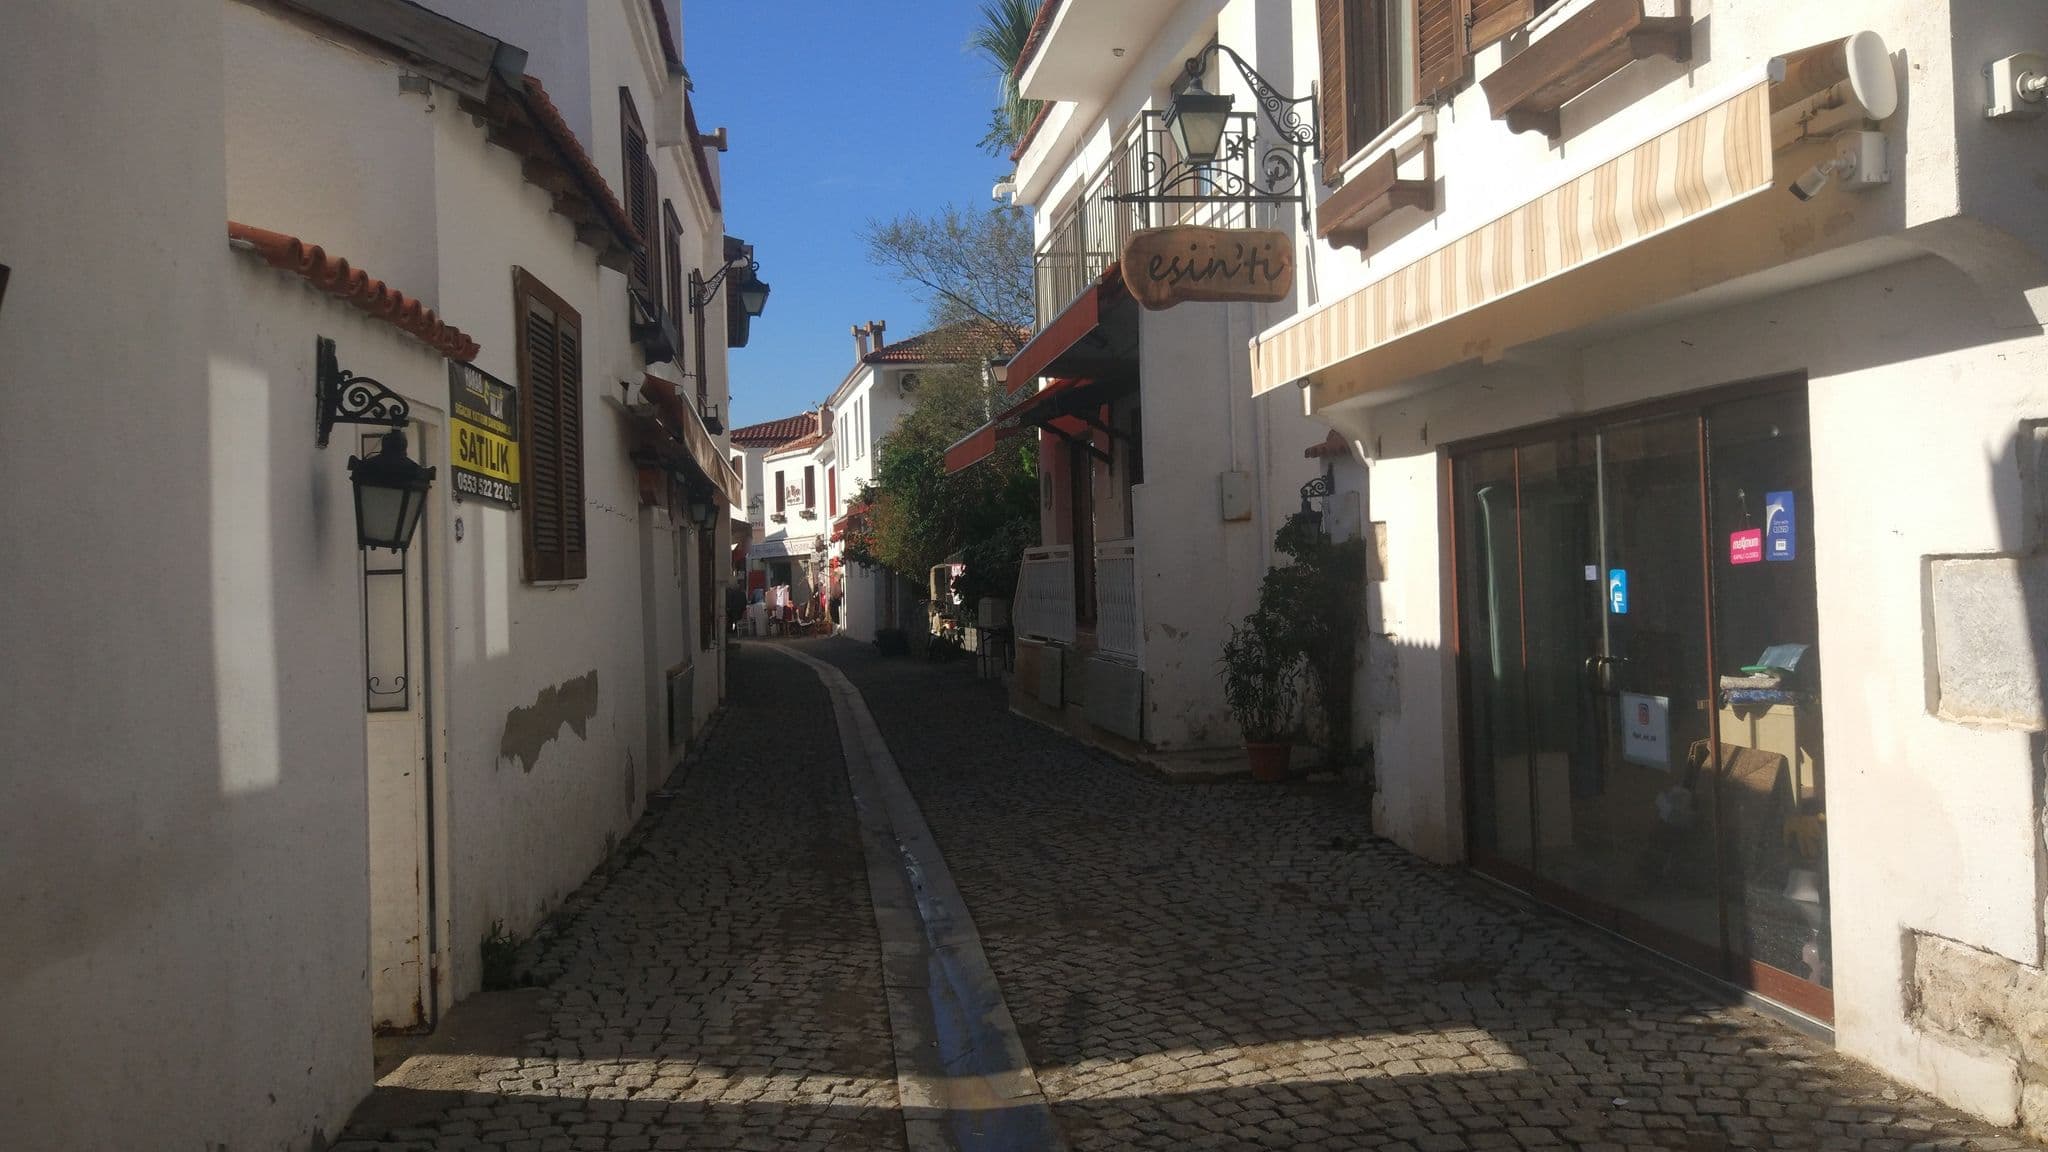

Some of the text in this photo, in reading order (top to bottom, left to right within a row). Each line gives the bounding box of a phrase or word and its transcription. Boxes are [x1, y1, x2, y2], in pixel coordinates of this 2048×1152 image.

[1148, 242, 1285, 284] esin'ti
[459, 428, 510, 475] SATILIK
[457, 472, 477, 493] 0553
[478, 478, 493, 497] 522
[493, 482, 504, 499] 22
